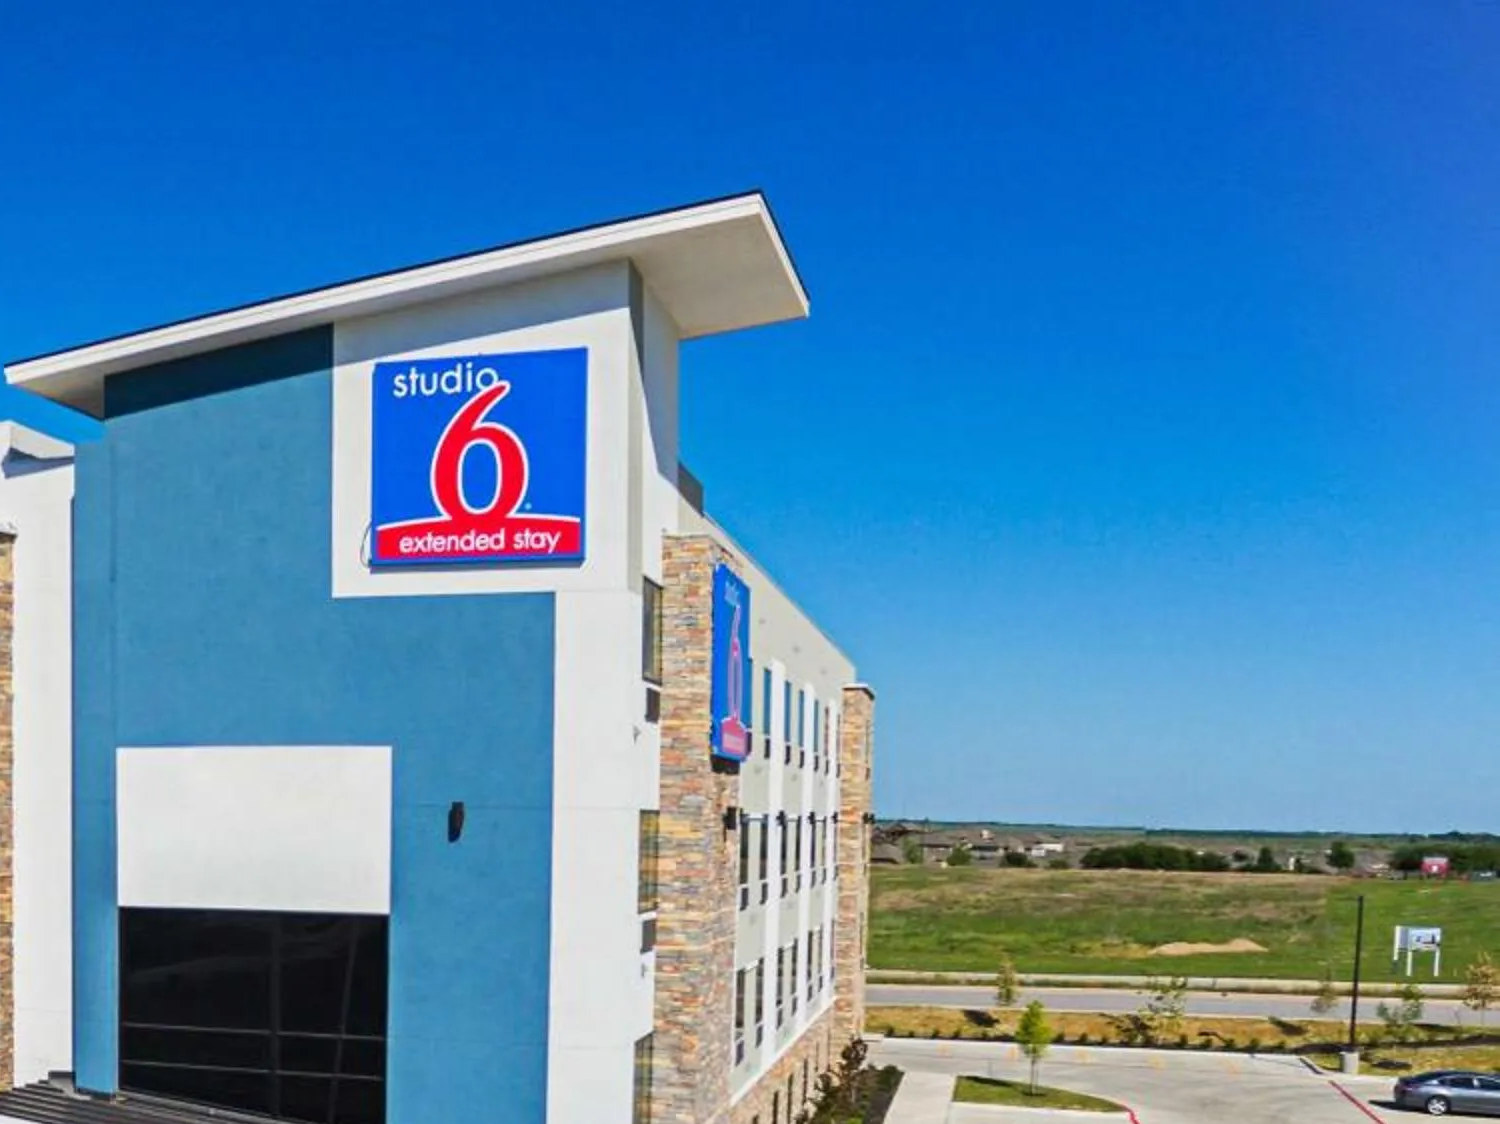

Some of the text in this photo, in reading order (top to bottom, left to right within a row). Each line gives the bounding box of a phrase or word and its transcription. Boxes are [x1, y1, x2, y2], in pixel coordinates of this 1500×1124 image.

[393, 362, 498, 398] studio
[431, 380, 528, 518] 6
[399, 529, 561, 554] extended stay
